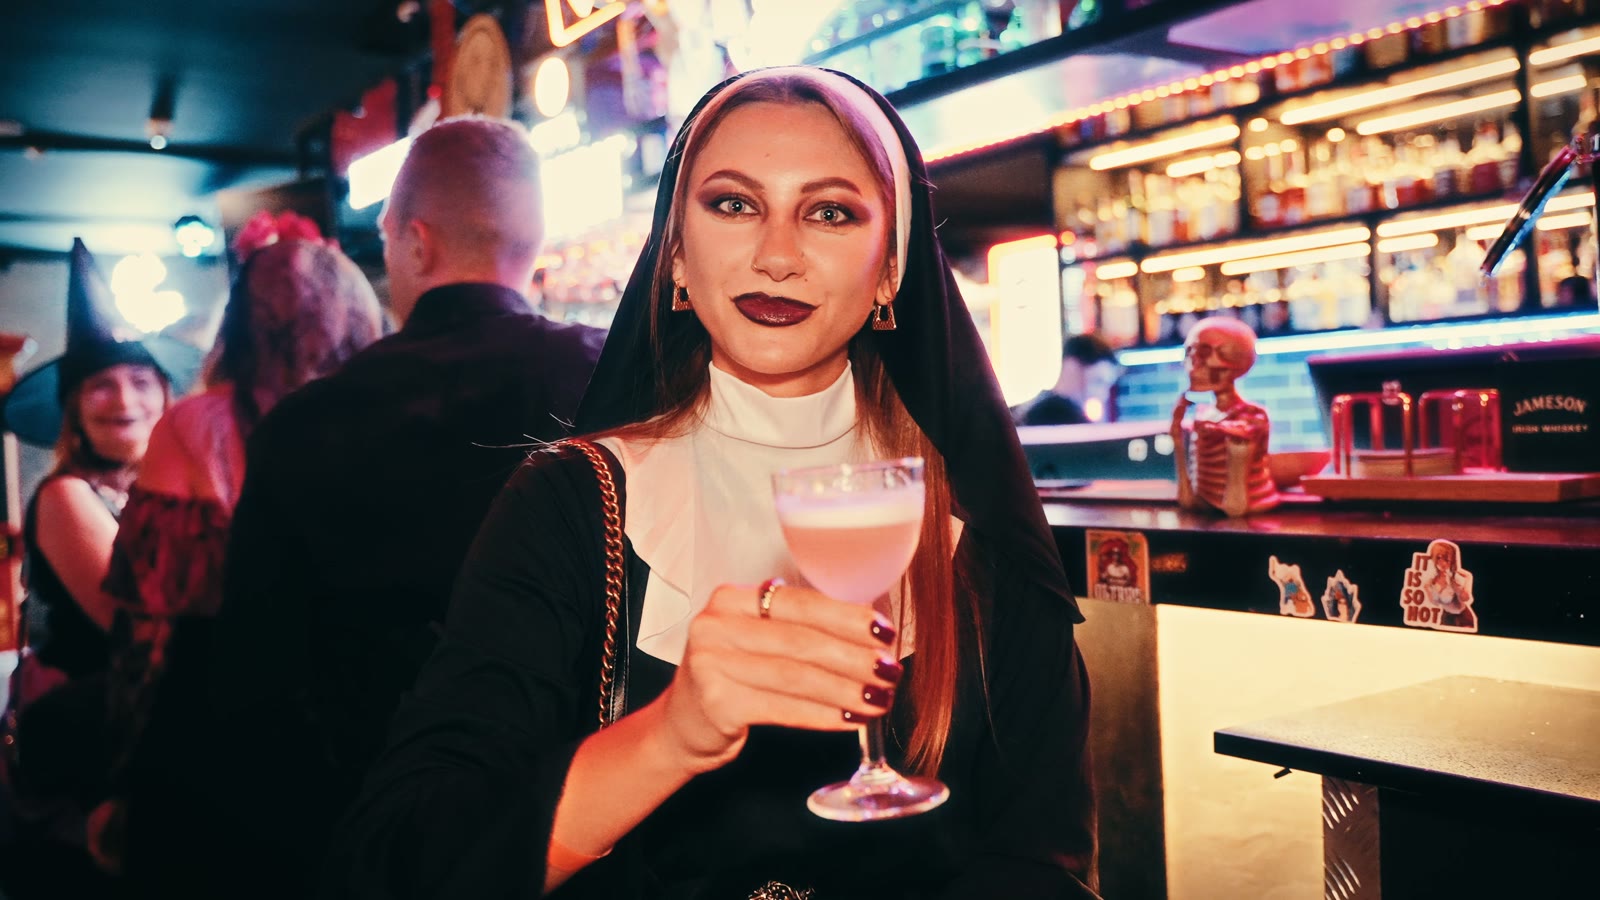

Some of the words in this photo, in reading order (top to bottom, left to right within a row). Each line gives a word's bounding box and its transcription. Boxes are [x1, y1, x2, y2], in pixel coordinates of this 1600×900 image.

[1513, 395, 1586, 416] JAMESON
[1541, 424, 1588, 433] WHISKEY
[1415, 555, 1431, 571] IT
[1407, 571, 1422, 587] IS
[1404, 589, 1424, 605] SO
[1407, 606, 1440, 623] HOT
